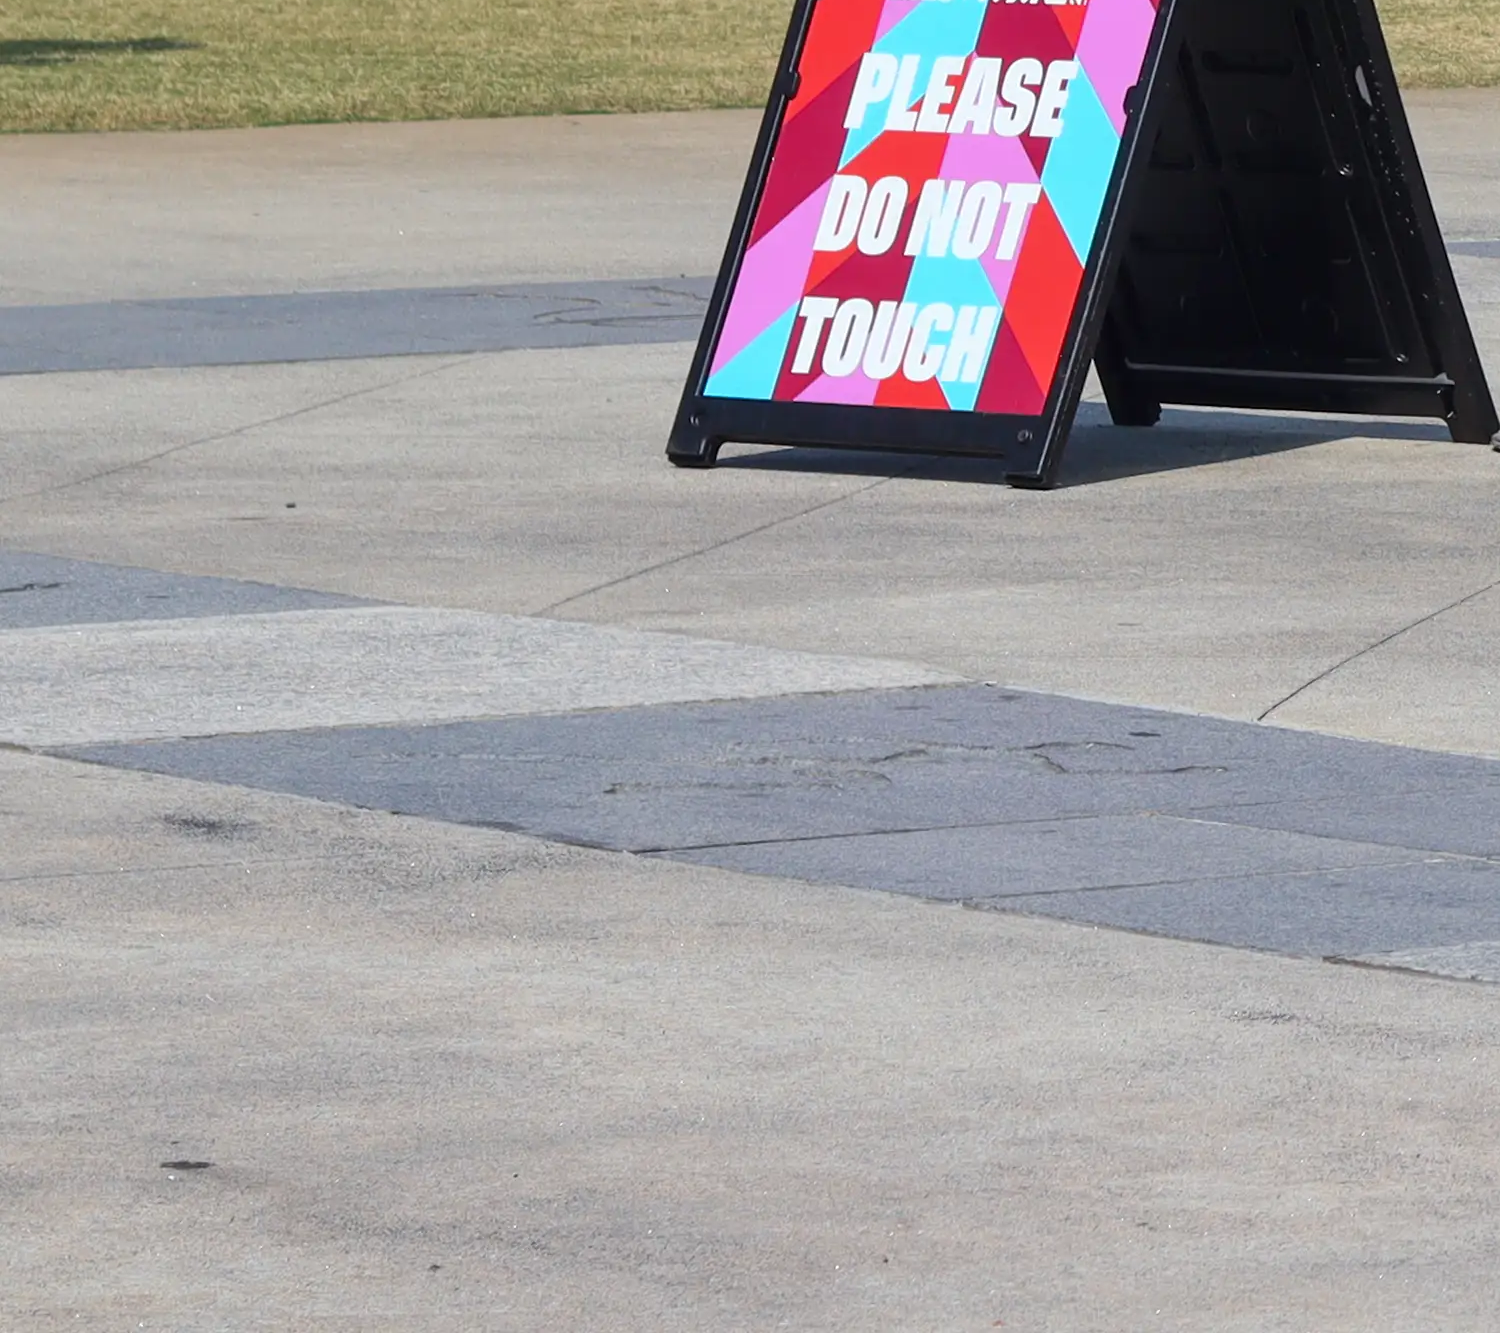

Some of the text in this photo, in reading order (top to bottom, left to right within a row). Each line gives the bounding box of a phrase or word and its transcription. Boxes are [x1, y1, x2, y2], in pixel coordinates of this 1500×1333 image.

[843, 52, 1079, 139] PLEASE
[814, 173, 1042, 261] DO NOT
[790, 295, 1002, 384] TOUCH
